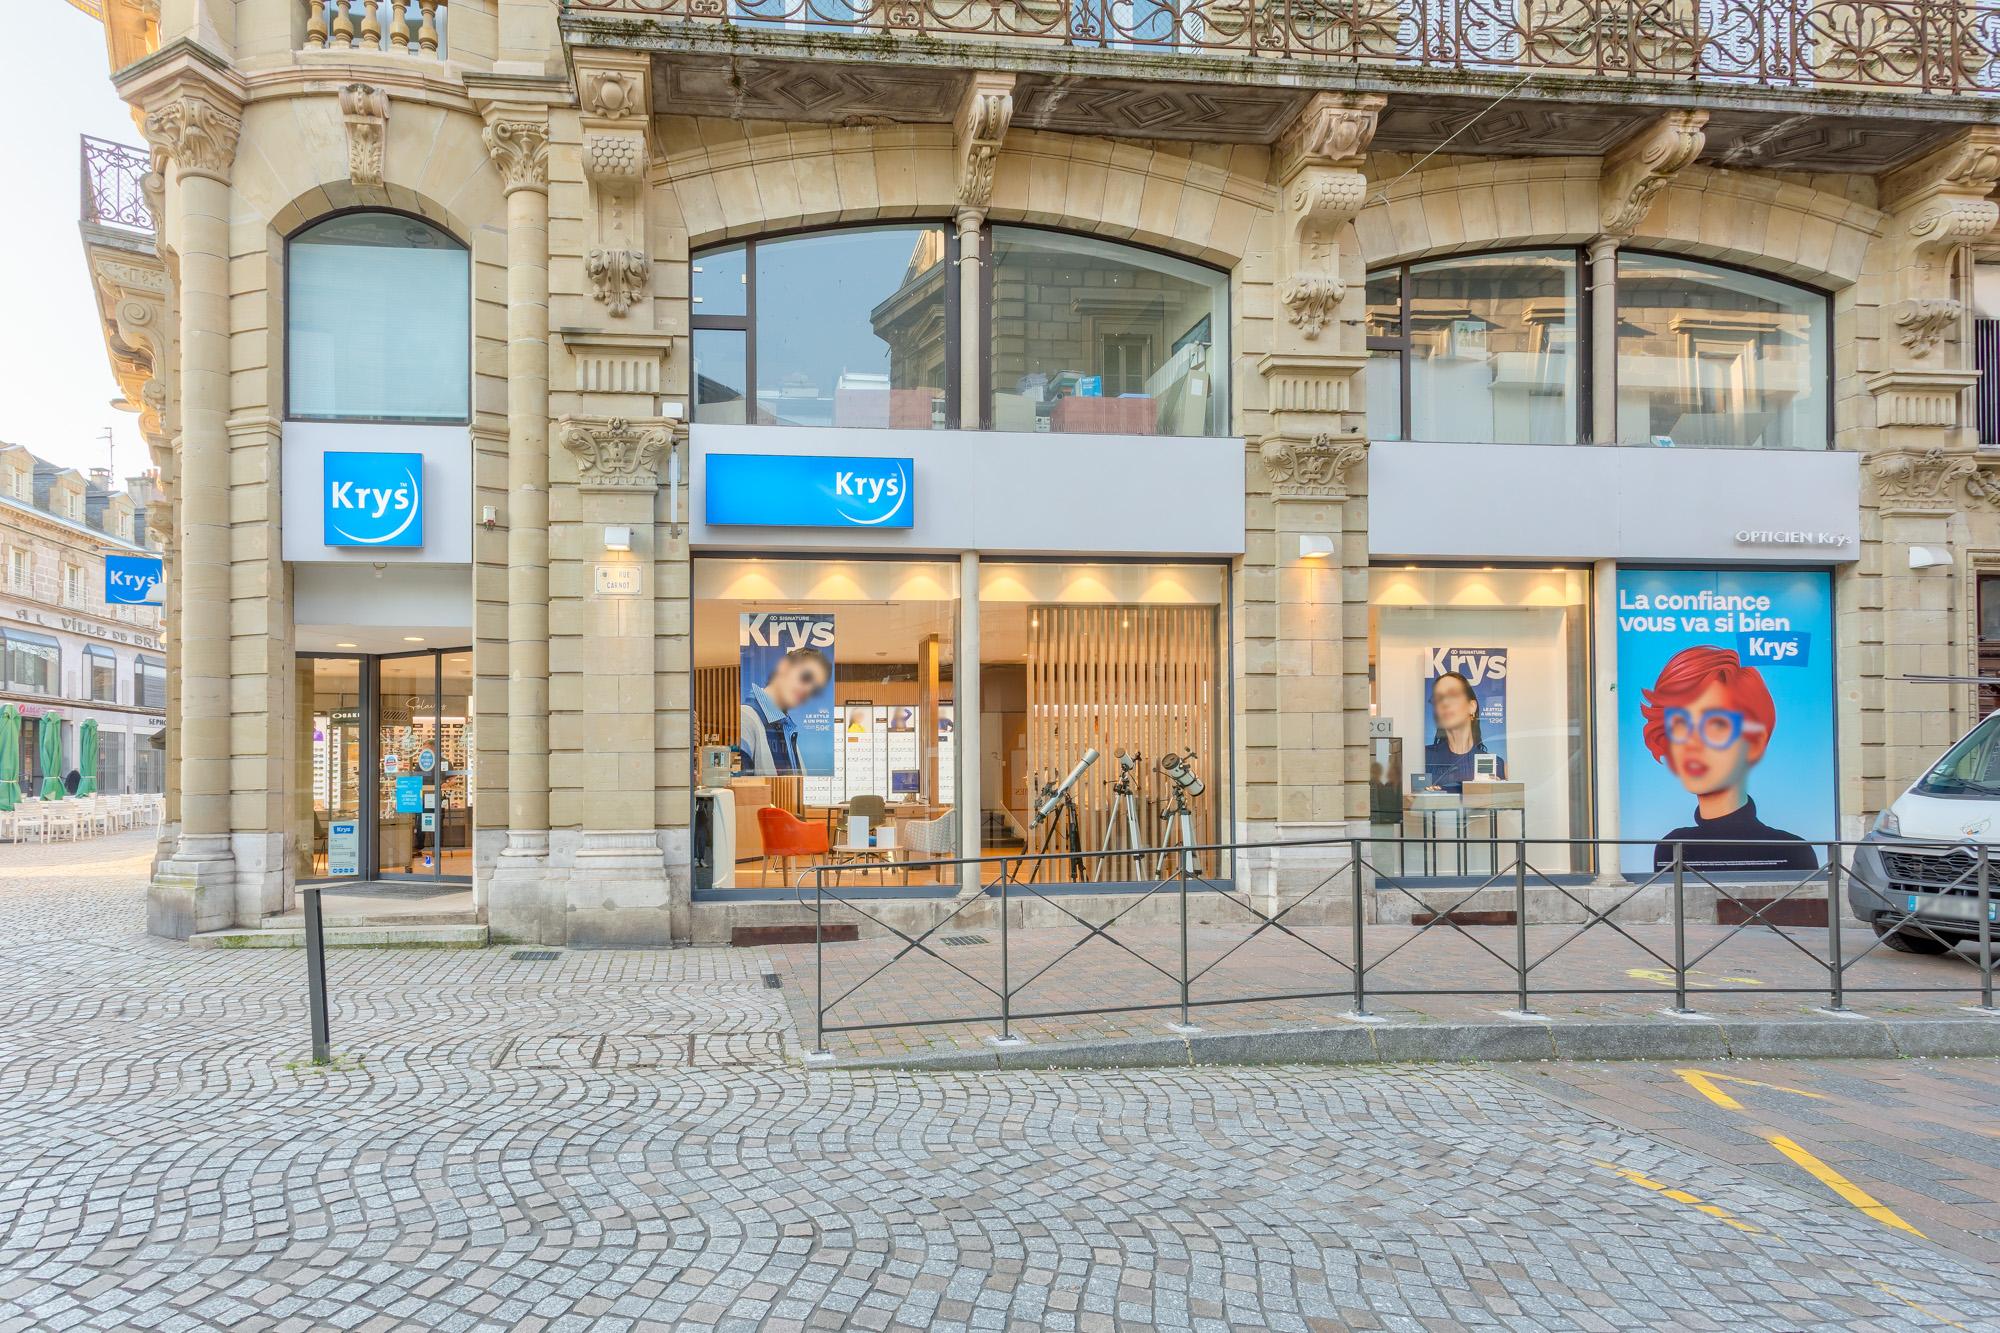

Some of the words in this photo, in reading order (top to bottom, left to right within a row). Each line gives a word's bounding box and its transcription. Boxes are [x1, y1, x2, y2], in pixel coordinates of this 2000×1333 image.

[836, 472, 899, 503] Krys
[332, 481, 409, 518] Krys
[1735, 530, 1813, 543] OPTICIEN
[1818, 532, 1853, 547] Krys
[110, 570, 156, 591] Krys
[1619, 589, 1649, 610] La
[1654, 589, 1771, 611] confiance
[61, 617, 107, 636] VILLE
[739, 613, 835, 655] Krys
[1619, 616, 1677, 632] vous
[1680, 616, 1710, 632] va
[1714, 613, 1734, 632] si
[1739, 613, 1791, 632] bien
[1749, 637, 1799, 661] Krys
[1424, 648, 1507, 687] Krys
